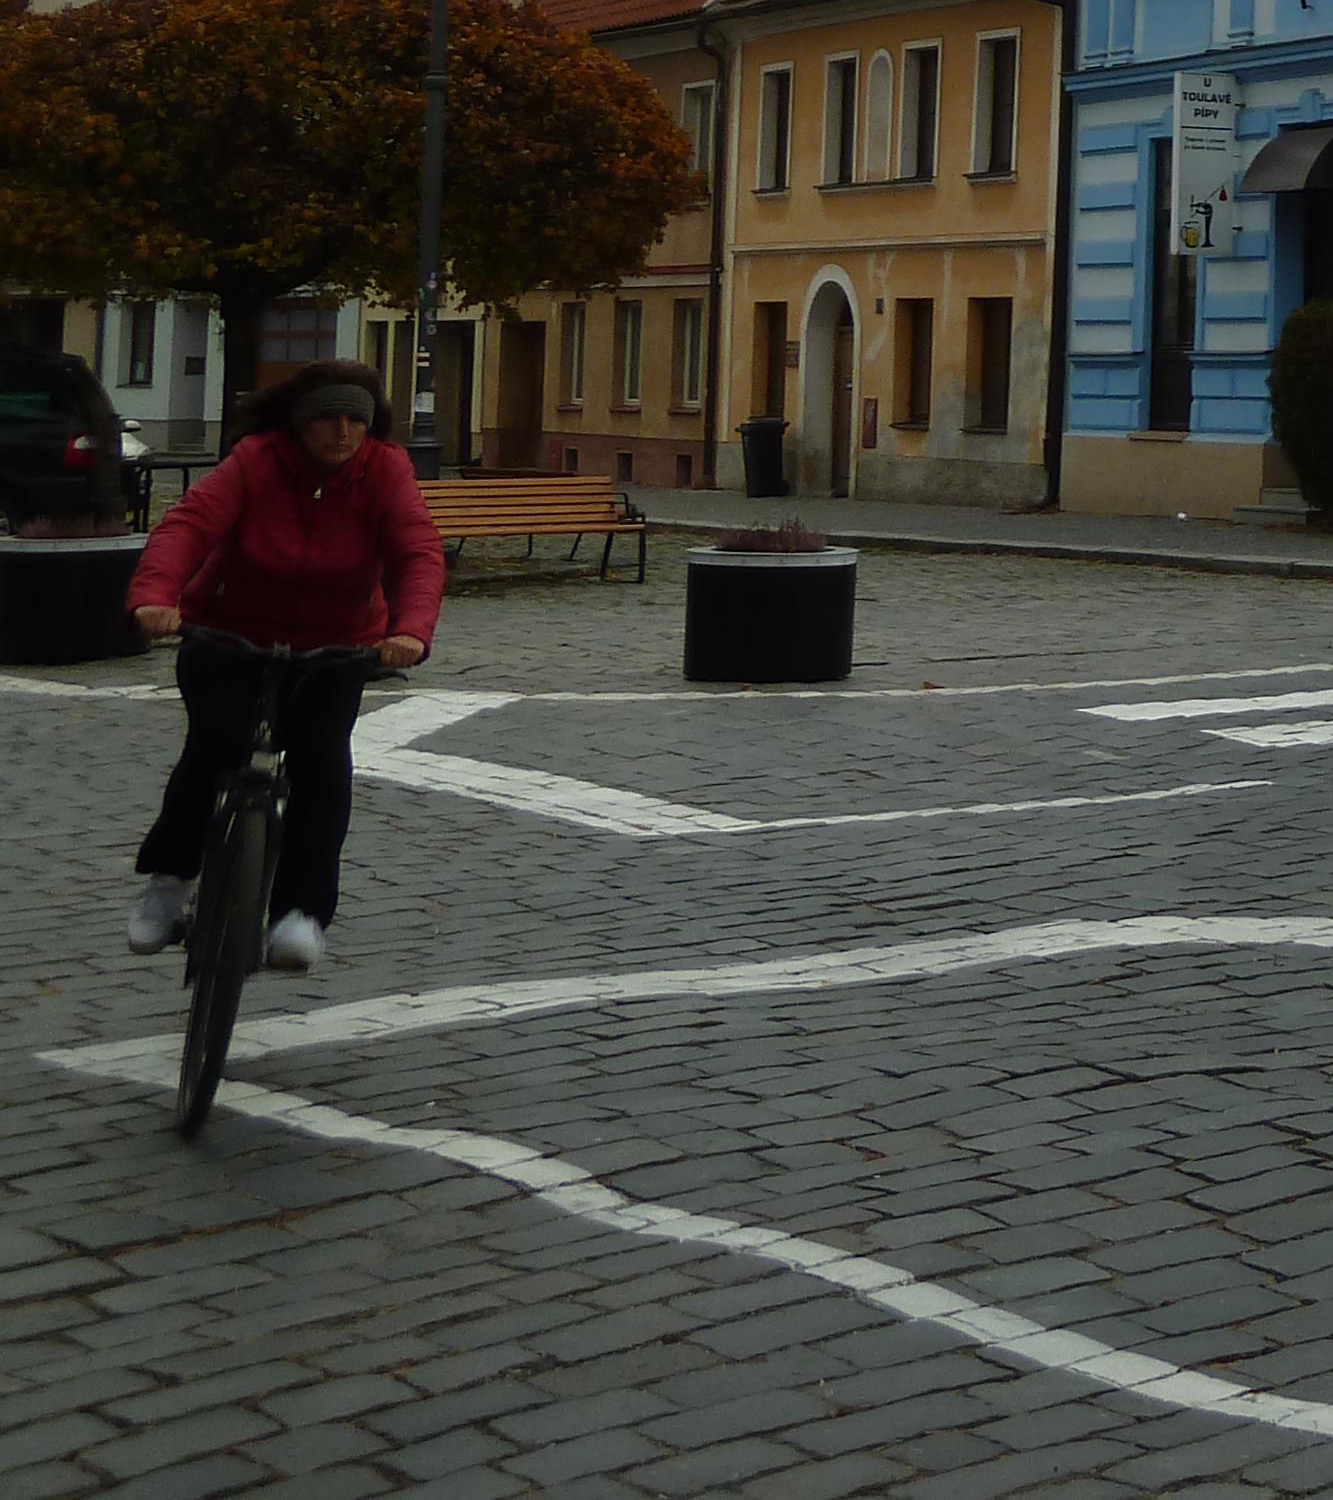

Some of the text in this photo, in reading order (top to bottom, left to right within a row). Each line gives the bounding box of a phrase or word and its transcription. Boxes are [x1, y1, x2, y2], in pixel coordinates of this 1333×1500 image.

[1203, 77, 1212, 88] U
[1182, 91, 1232, 104] TOULAVÉ
[1193, 106, 1220, 119] PÍPY
